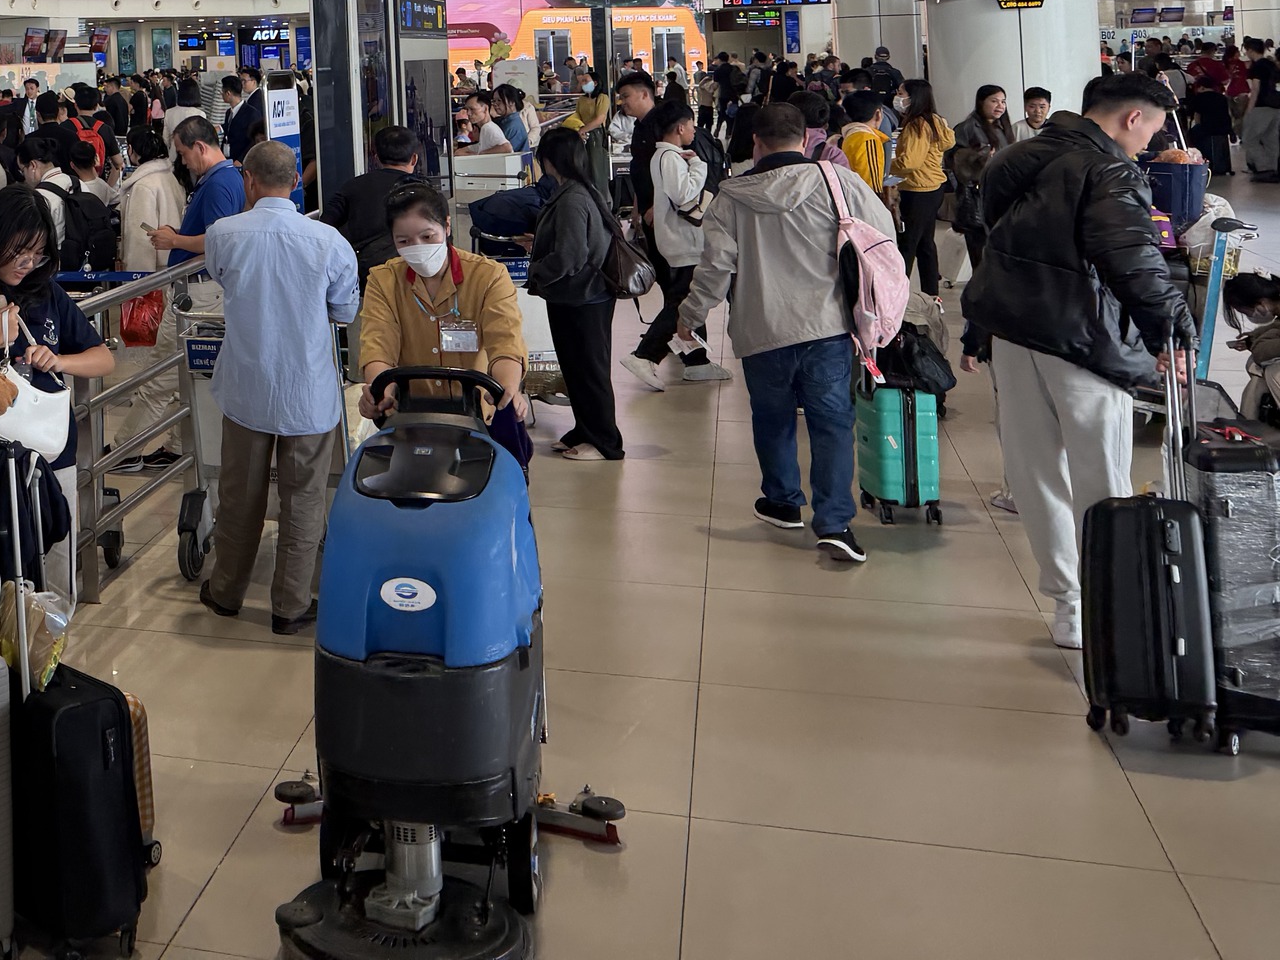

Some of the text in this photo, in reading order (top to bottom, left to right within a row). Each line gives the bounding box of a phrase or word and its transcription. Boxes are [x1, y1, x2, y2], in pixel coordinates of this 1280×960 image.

[253, 30, 279, 41] ACV
[1101, 30, 1116, 40] B02
[272, 100, 285, 118] ACV
